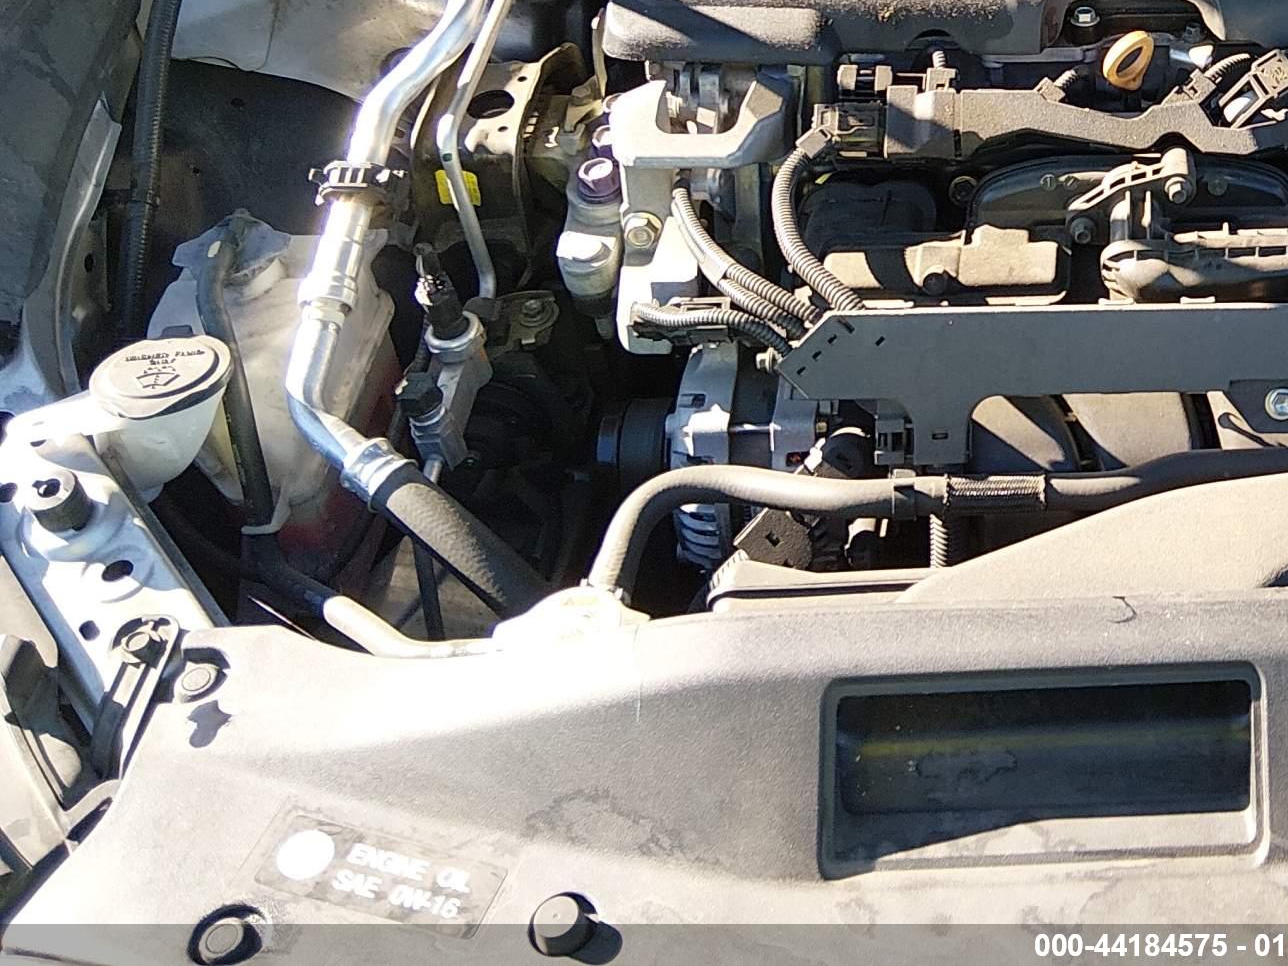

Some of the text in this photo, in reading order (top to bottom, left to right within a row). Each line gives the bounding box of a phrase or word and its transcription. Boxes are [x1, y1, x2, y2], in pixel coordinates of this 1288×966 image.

[333, 868, 462, 920] SAE 0W-16
[346, 842, 472, 894] ENGINE OIL
